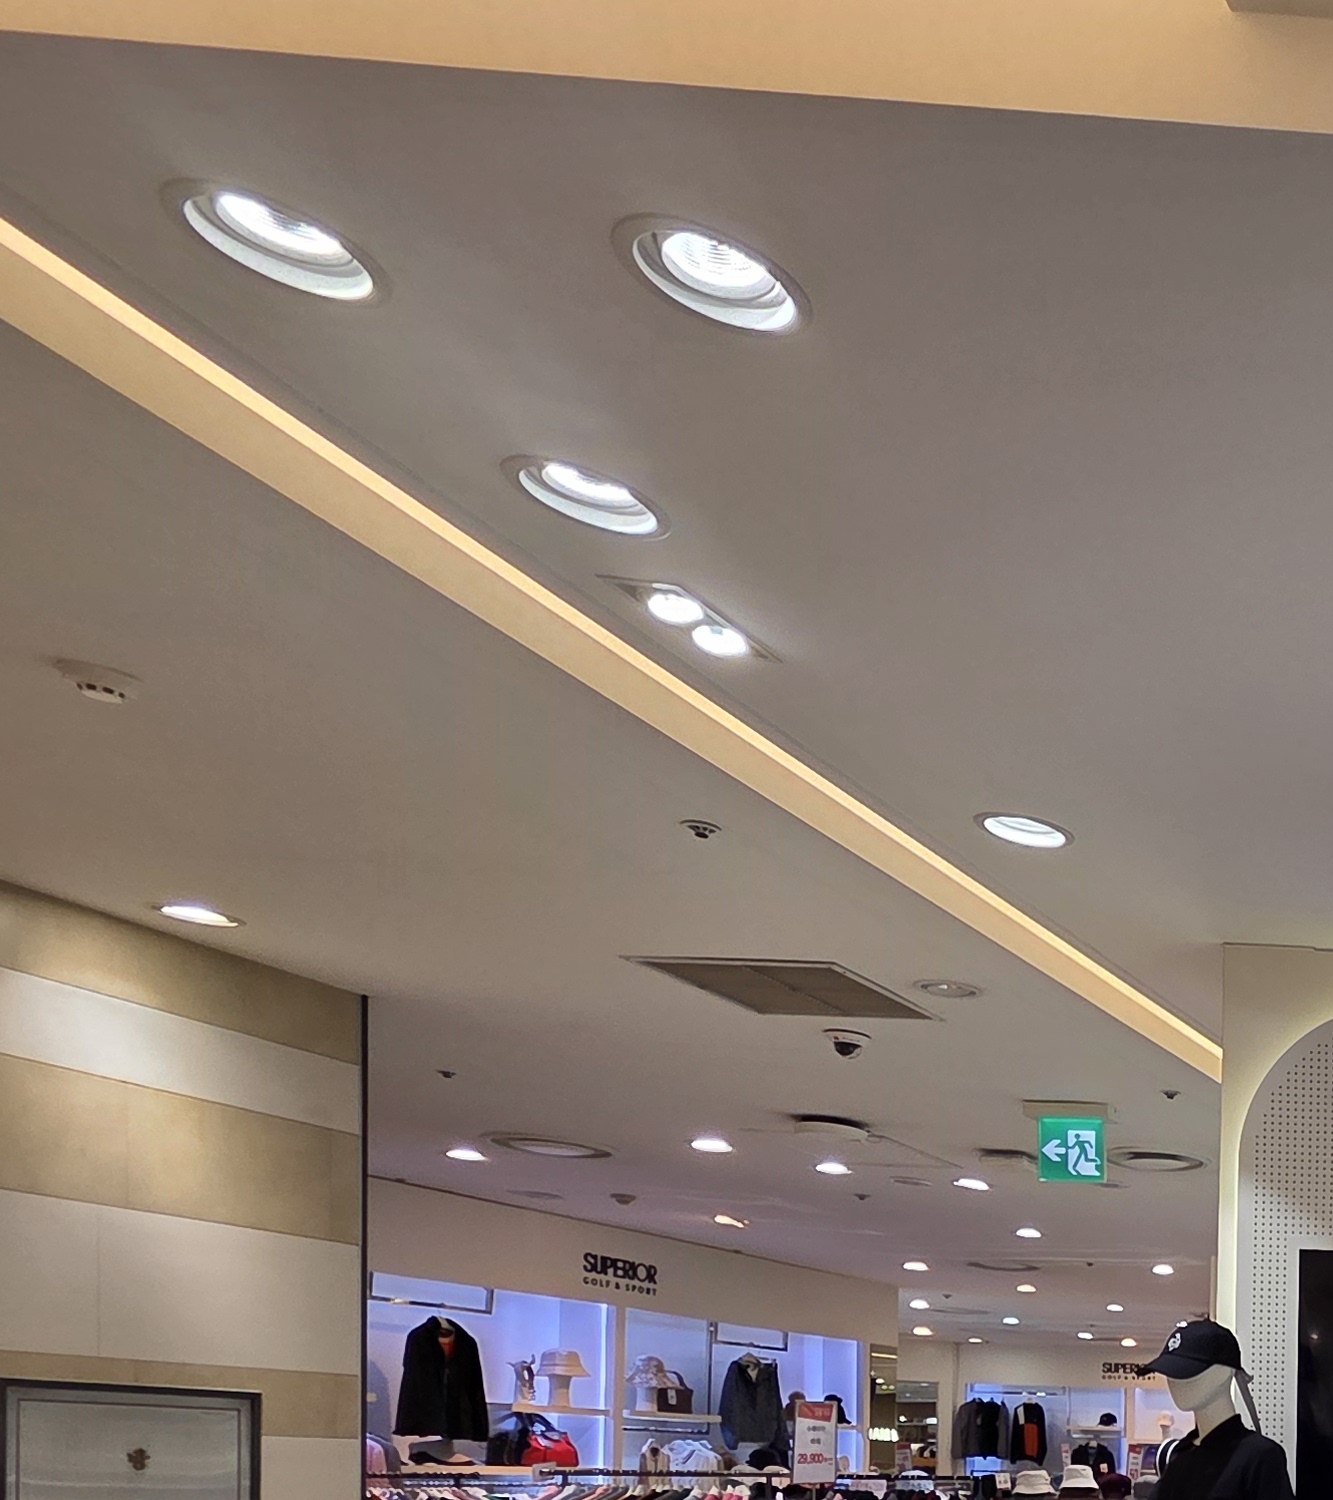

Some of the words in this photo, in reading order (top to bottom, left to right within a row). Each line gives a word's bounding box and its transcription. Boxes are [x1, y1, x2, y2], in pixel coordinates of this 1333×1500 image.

[583, 1252, 658, 1285] SUPERIOR
[583, 1276, 611, 1288] GOLF
[625, 1283, 657, 1296] SPORT
